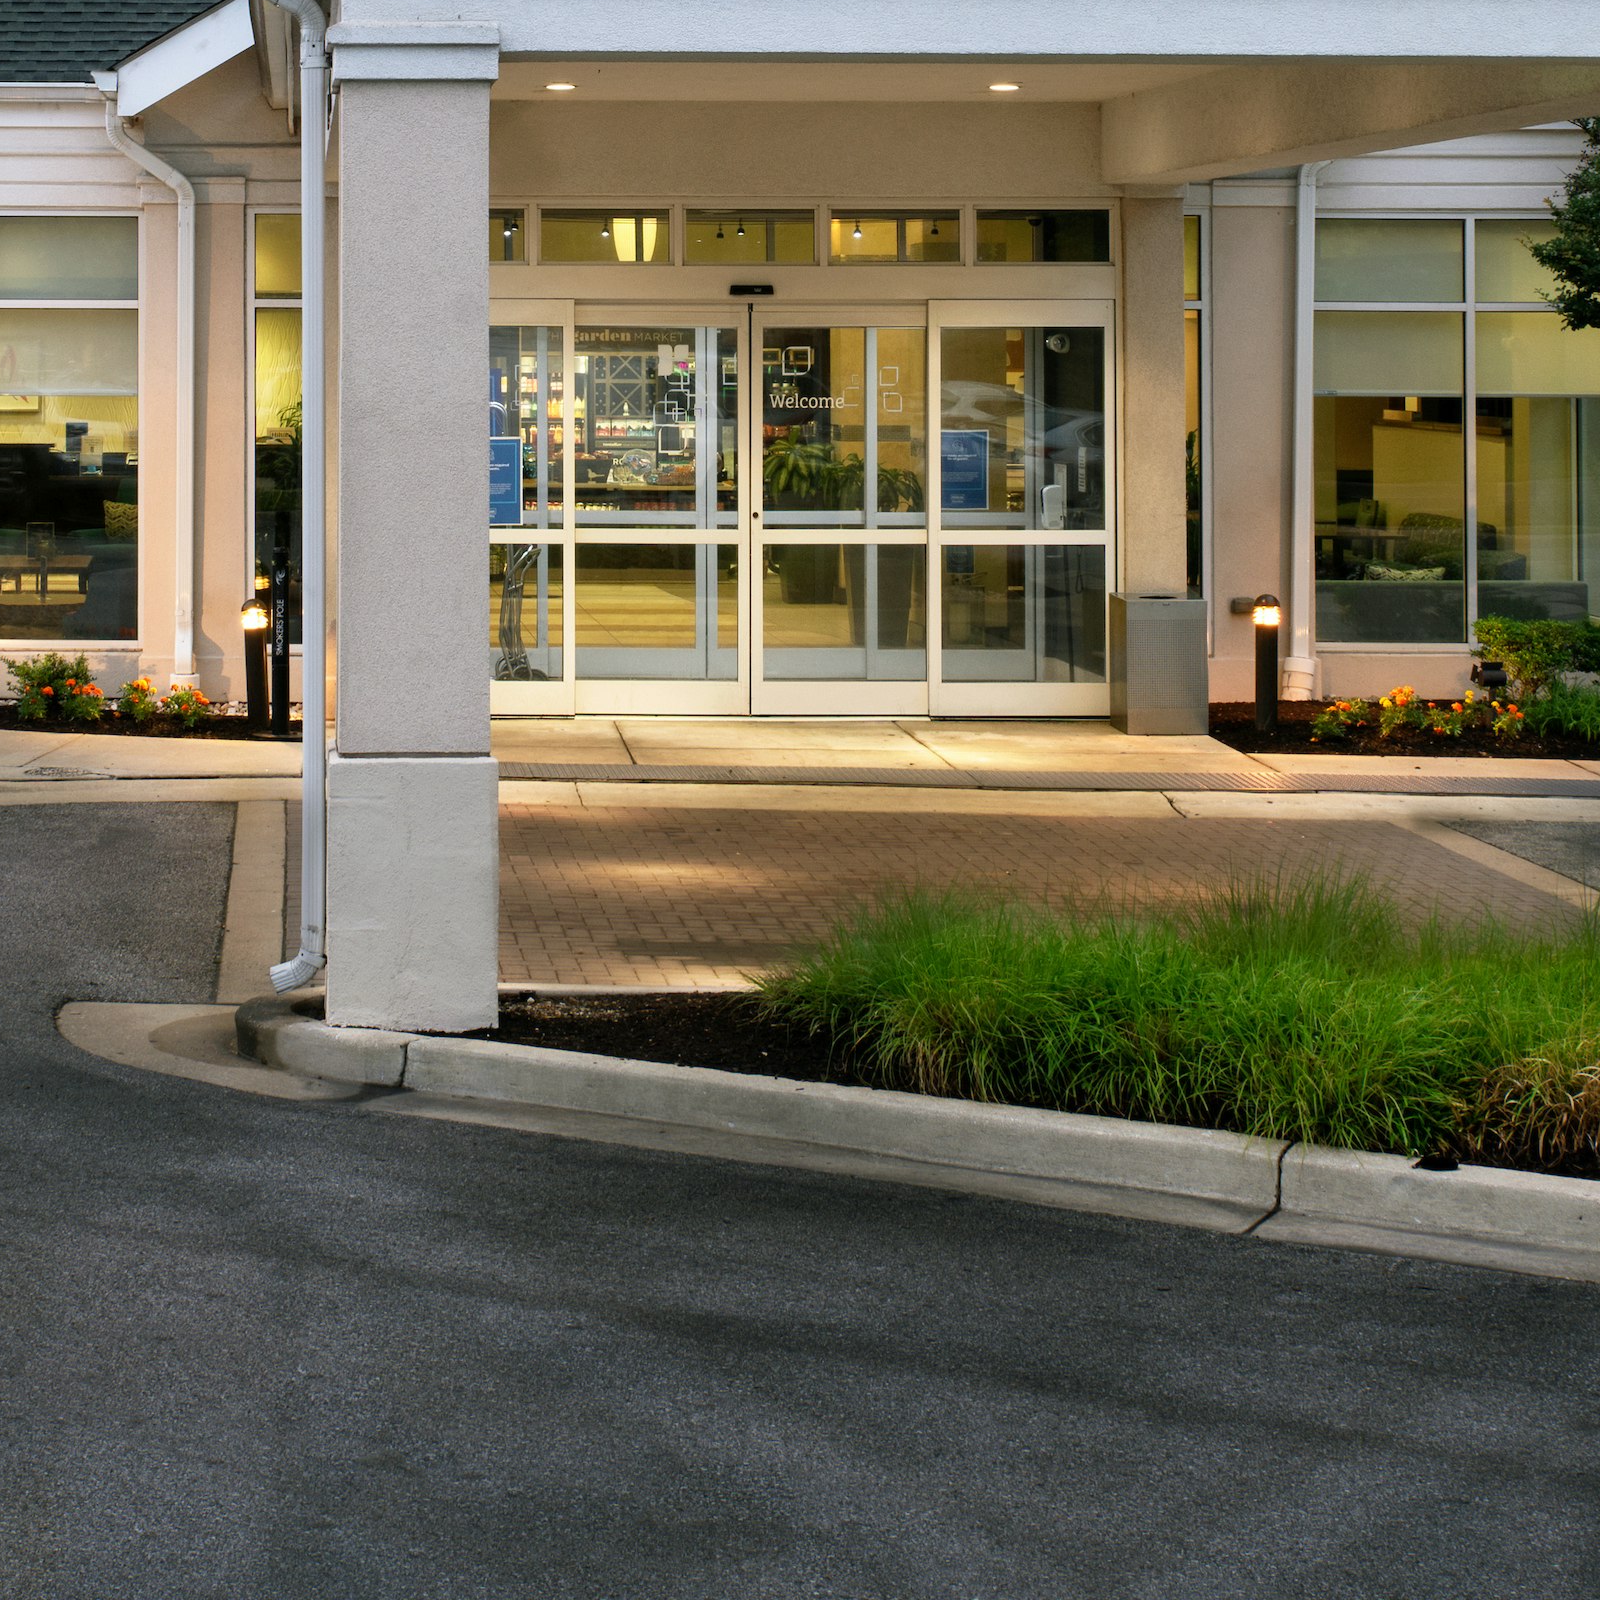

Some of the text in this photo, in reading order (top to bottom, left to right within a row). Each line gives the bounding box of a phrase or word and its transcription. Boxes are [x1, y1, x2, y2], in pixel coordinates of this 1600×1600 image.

[634, 332, 684, 343] MARKET
[769, 392, 845, 409] Welcome
[275, 599, 285, 656] SMOKERS POLE
